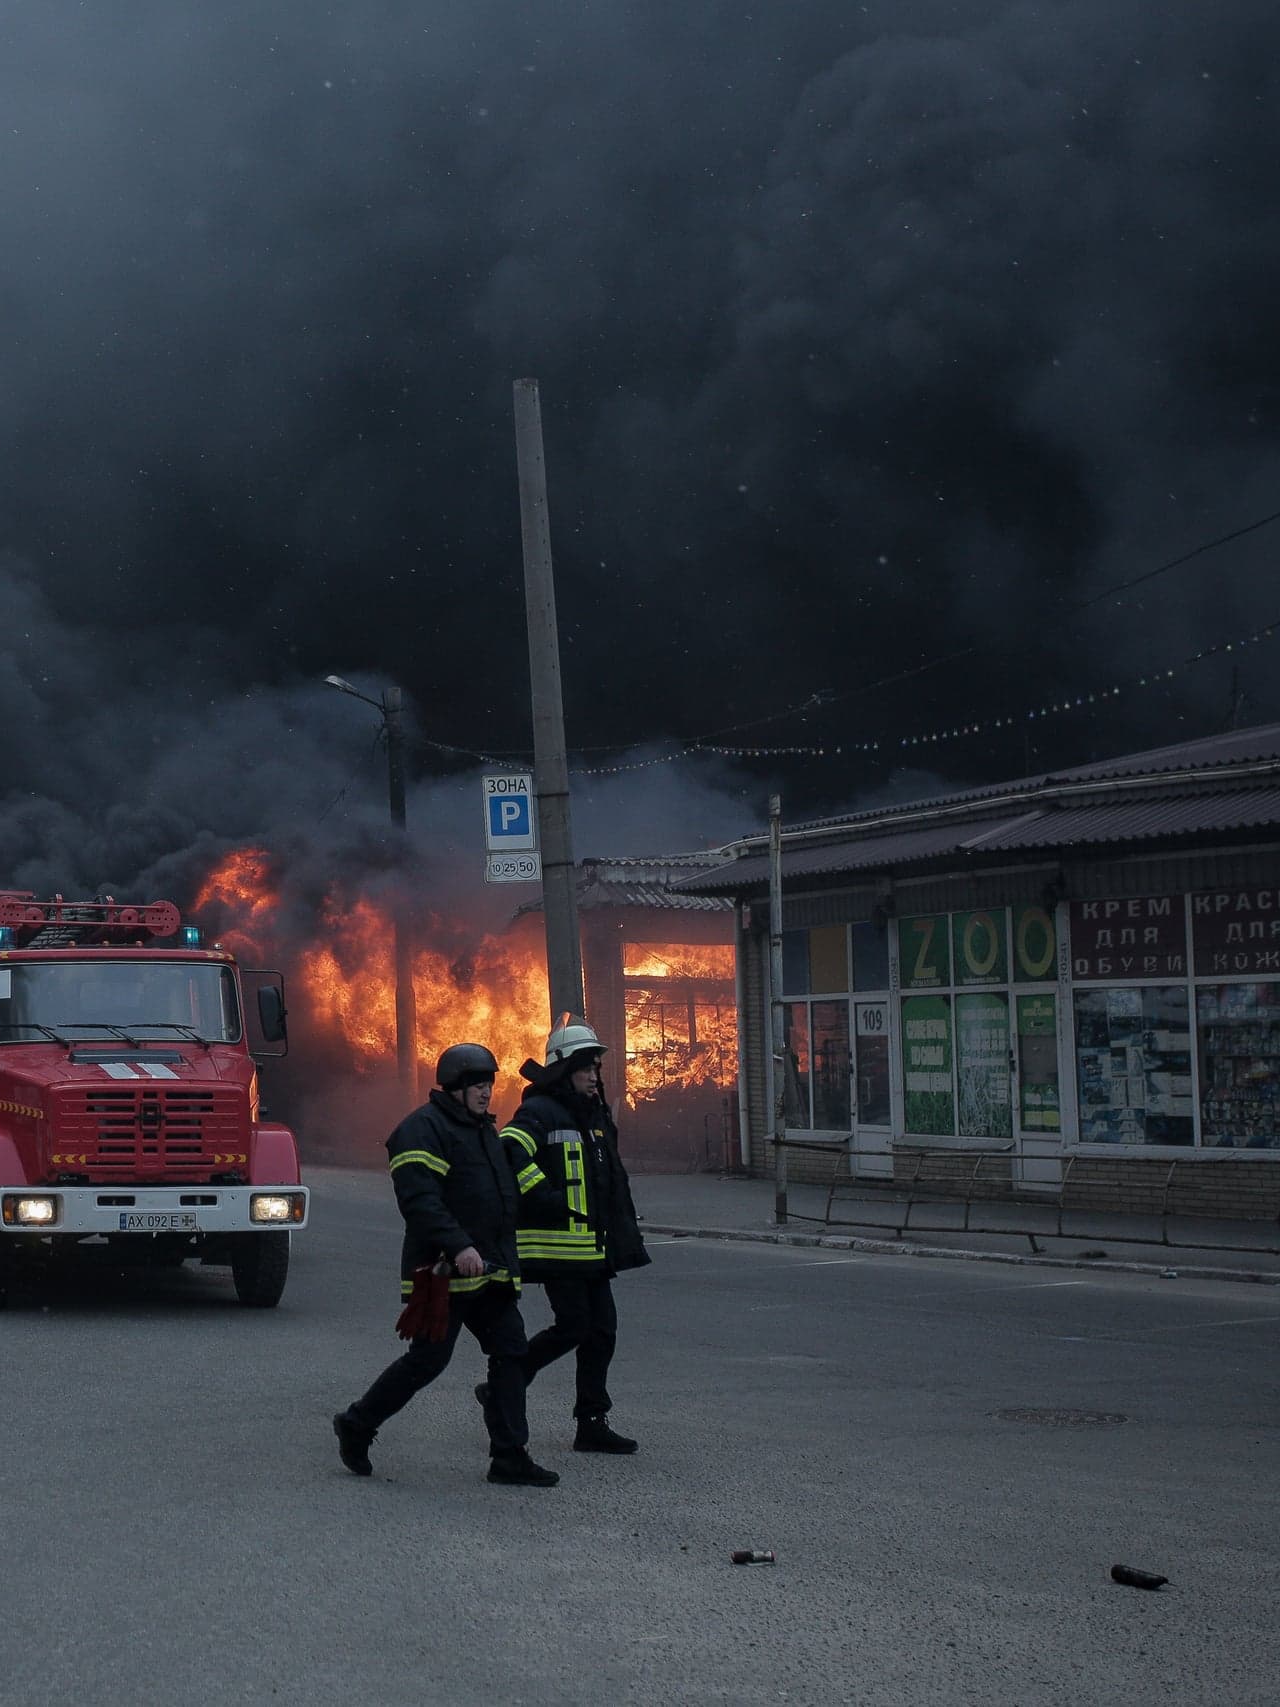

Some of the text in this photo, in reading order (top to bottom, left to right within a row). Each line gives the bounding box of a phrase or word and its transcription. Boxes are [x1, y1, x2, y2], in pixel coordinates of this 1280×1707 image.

[487, 779, 528, 793] ЗОНА
[501, 801, 521, 831] P
[504, 862, 517, 873] 25
[519, 861, 533, 872] 50
[1082, 897, 1171, 920] КРЕМ
[1194, 889, 1280, 914] КРАС
[912, 907, 1056, 979] ZOO
[1095, 926, 1160, 950] ДЛЯ
[1074, 954, 1183, 976] ОБУВИ
[862, 1008, 883, 1031] 109
[128, 1216, 144, 1228] AX
[147, 1215, 167, 1227] 092
